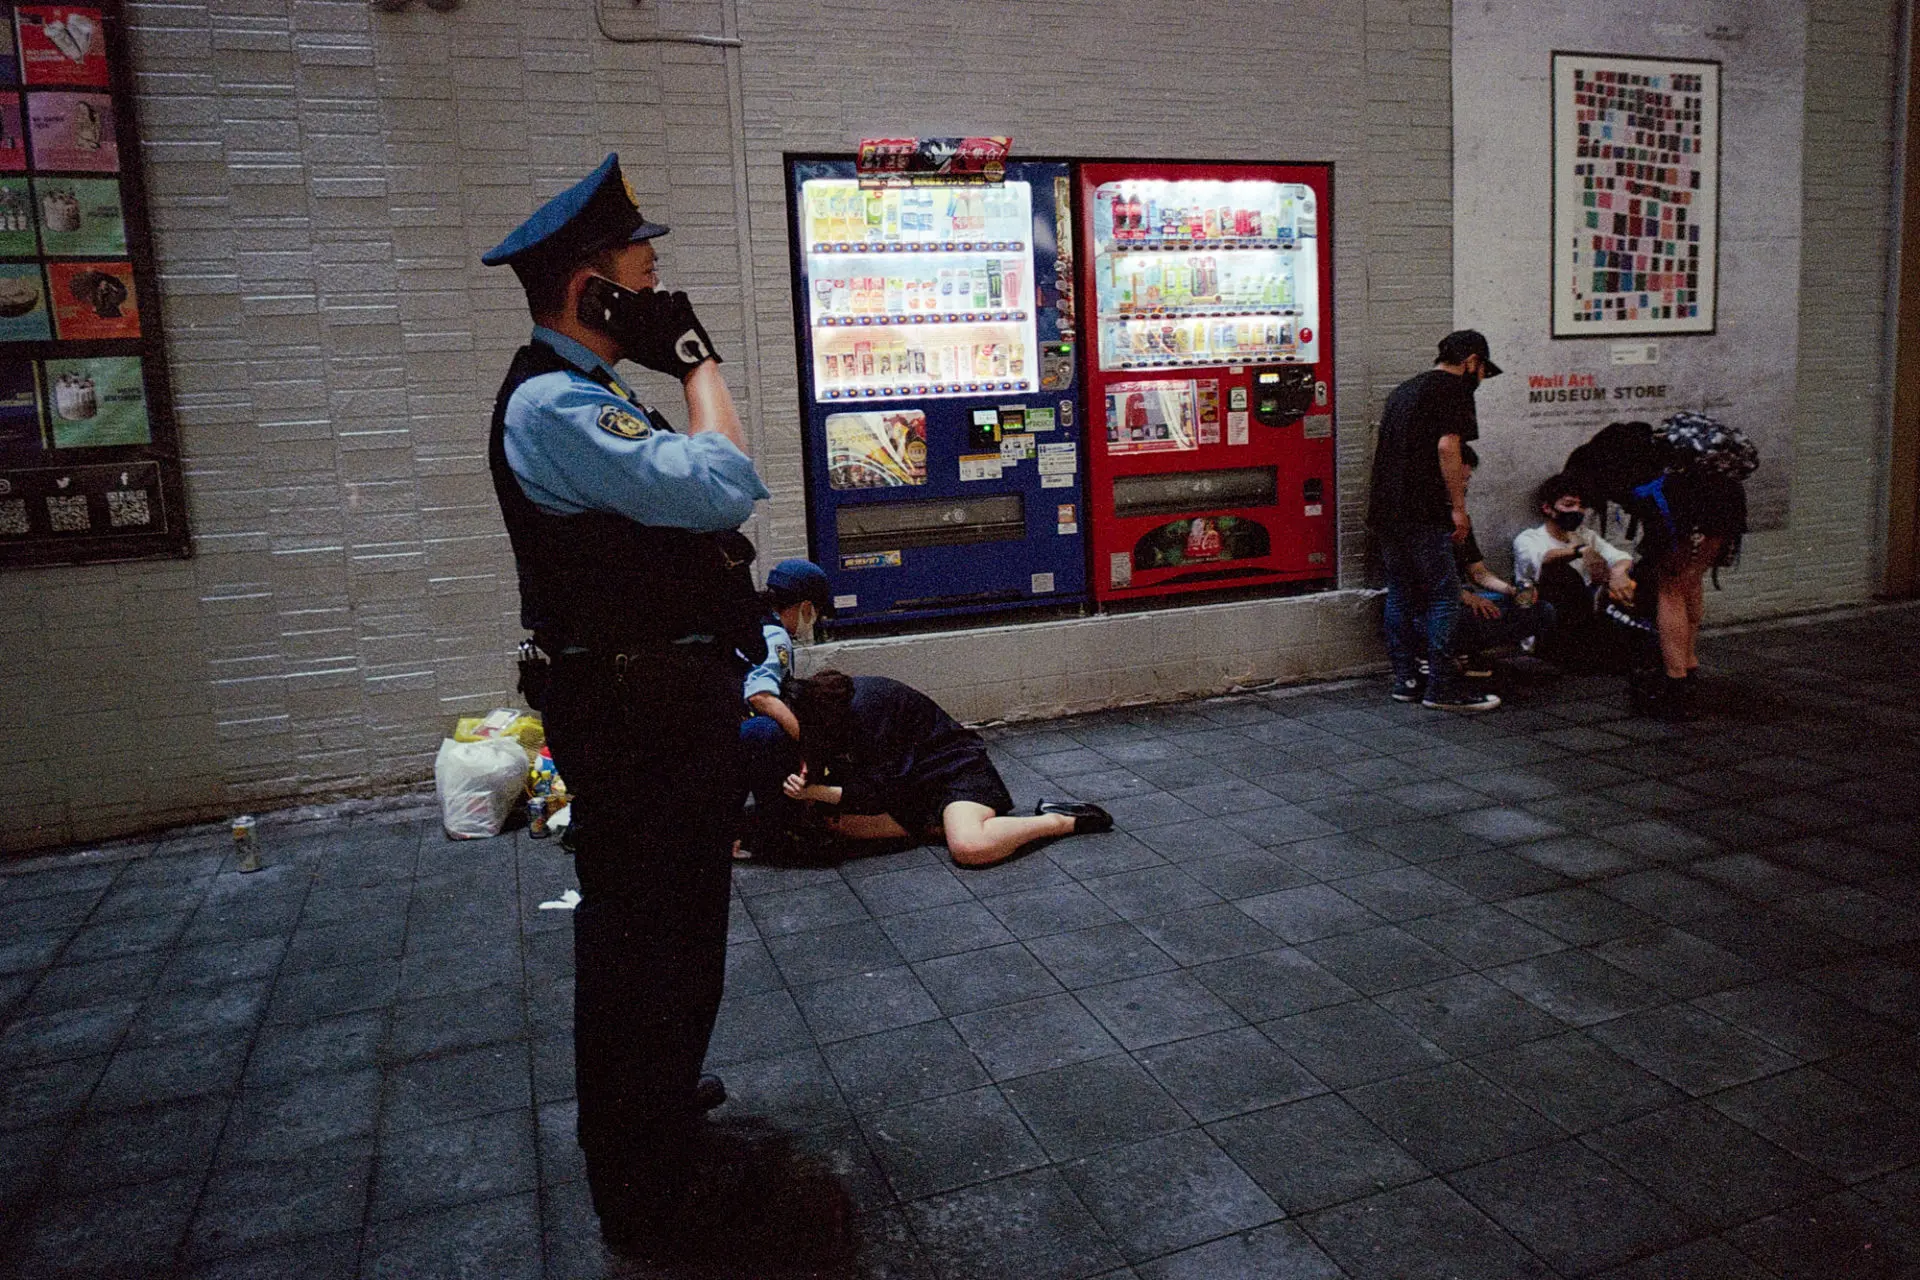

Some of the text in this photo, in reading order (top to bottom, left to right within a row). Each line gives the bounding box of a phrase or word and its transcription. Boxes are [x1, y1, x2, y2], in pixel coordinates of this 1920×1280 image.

[1528, 374, 1595, 388] Wall Art
[1529, 385, 1667, 403] MUSEUM STORE
